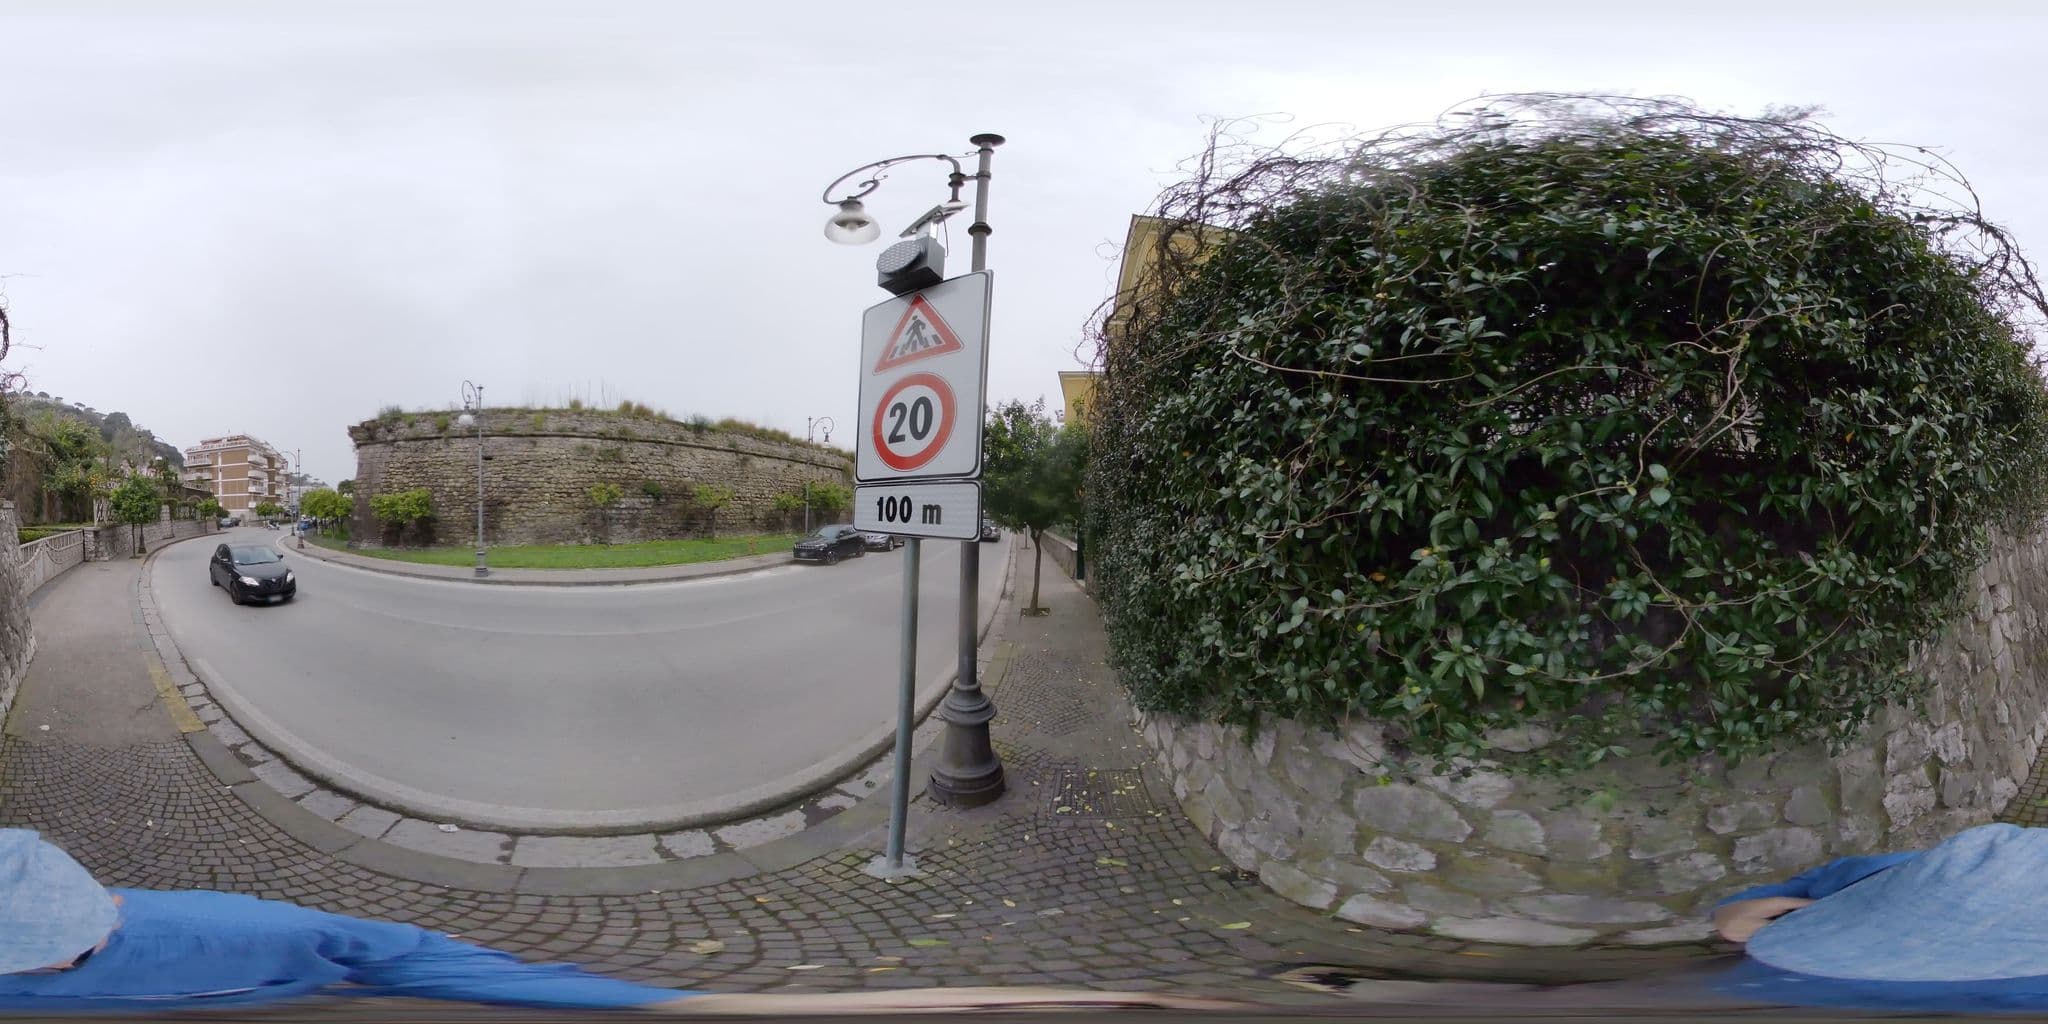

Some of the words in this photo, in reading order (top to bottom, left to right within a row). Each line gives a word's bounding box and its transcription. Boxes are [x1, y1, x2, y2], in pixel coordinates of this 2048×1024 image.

[888, 396, 933, 444] 20
[877, 496, 912, 523] 100
[922, 503, 942, 525] m
